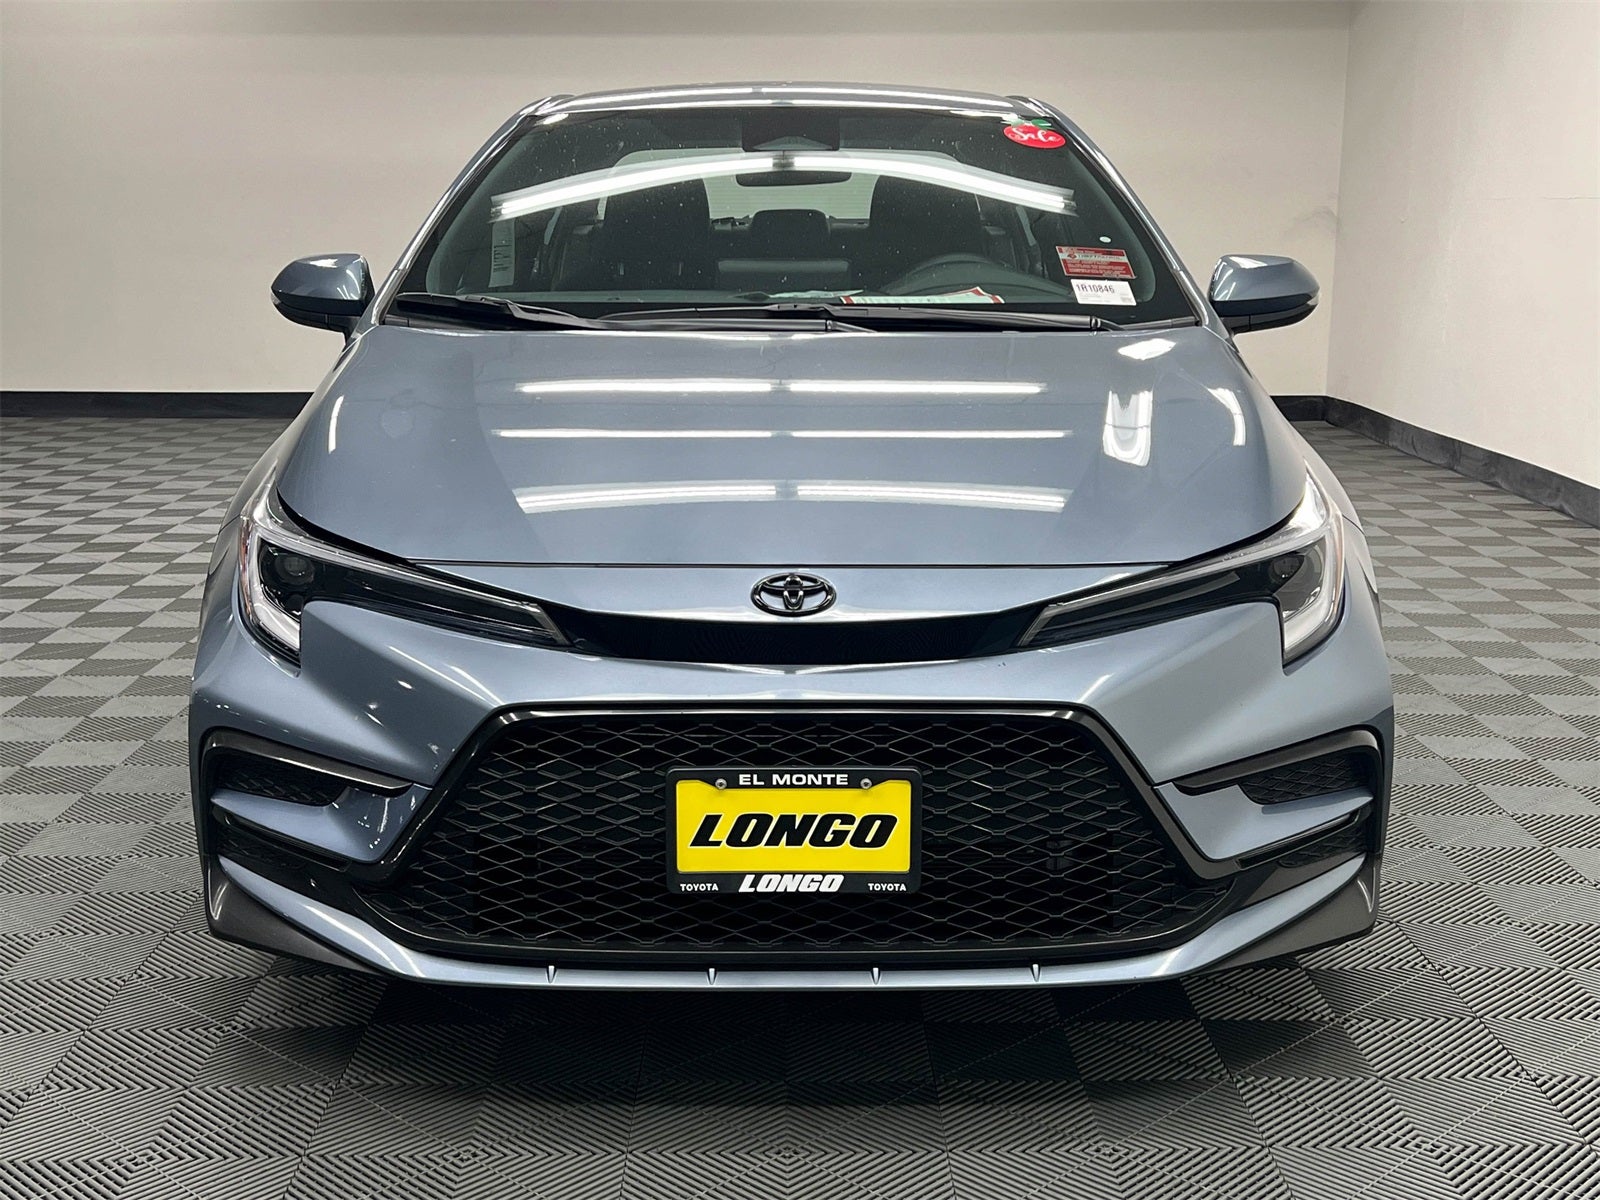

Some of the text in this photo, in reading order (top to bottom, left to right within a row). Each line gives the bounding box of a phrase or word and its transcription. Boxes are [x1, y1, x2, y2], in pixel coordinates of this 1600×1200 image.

[1008, 127, 1060, 143] Sale
[1076, 283, 1115, 294] 1R10846
[738, 774, 848, 785] EL MONTE
[688, 812, 898, 849] LONGO
[680, 883, 718, 892] TOYOTA
[738, 874, 844, 893] LONGO
[868, 883, 906, 892] TOYOTA
